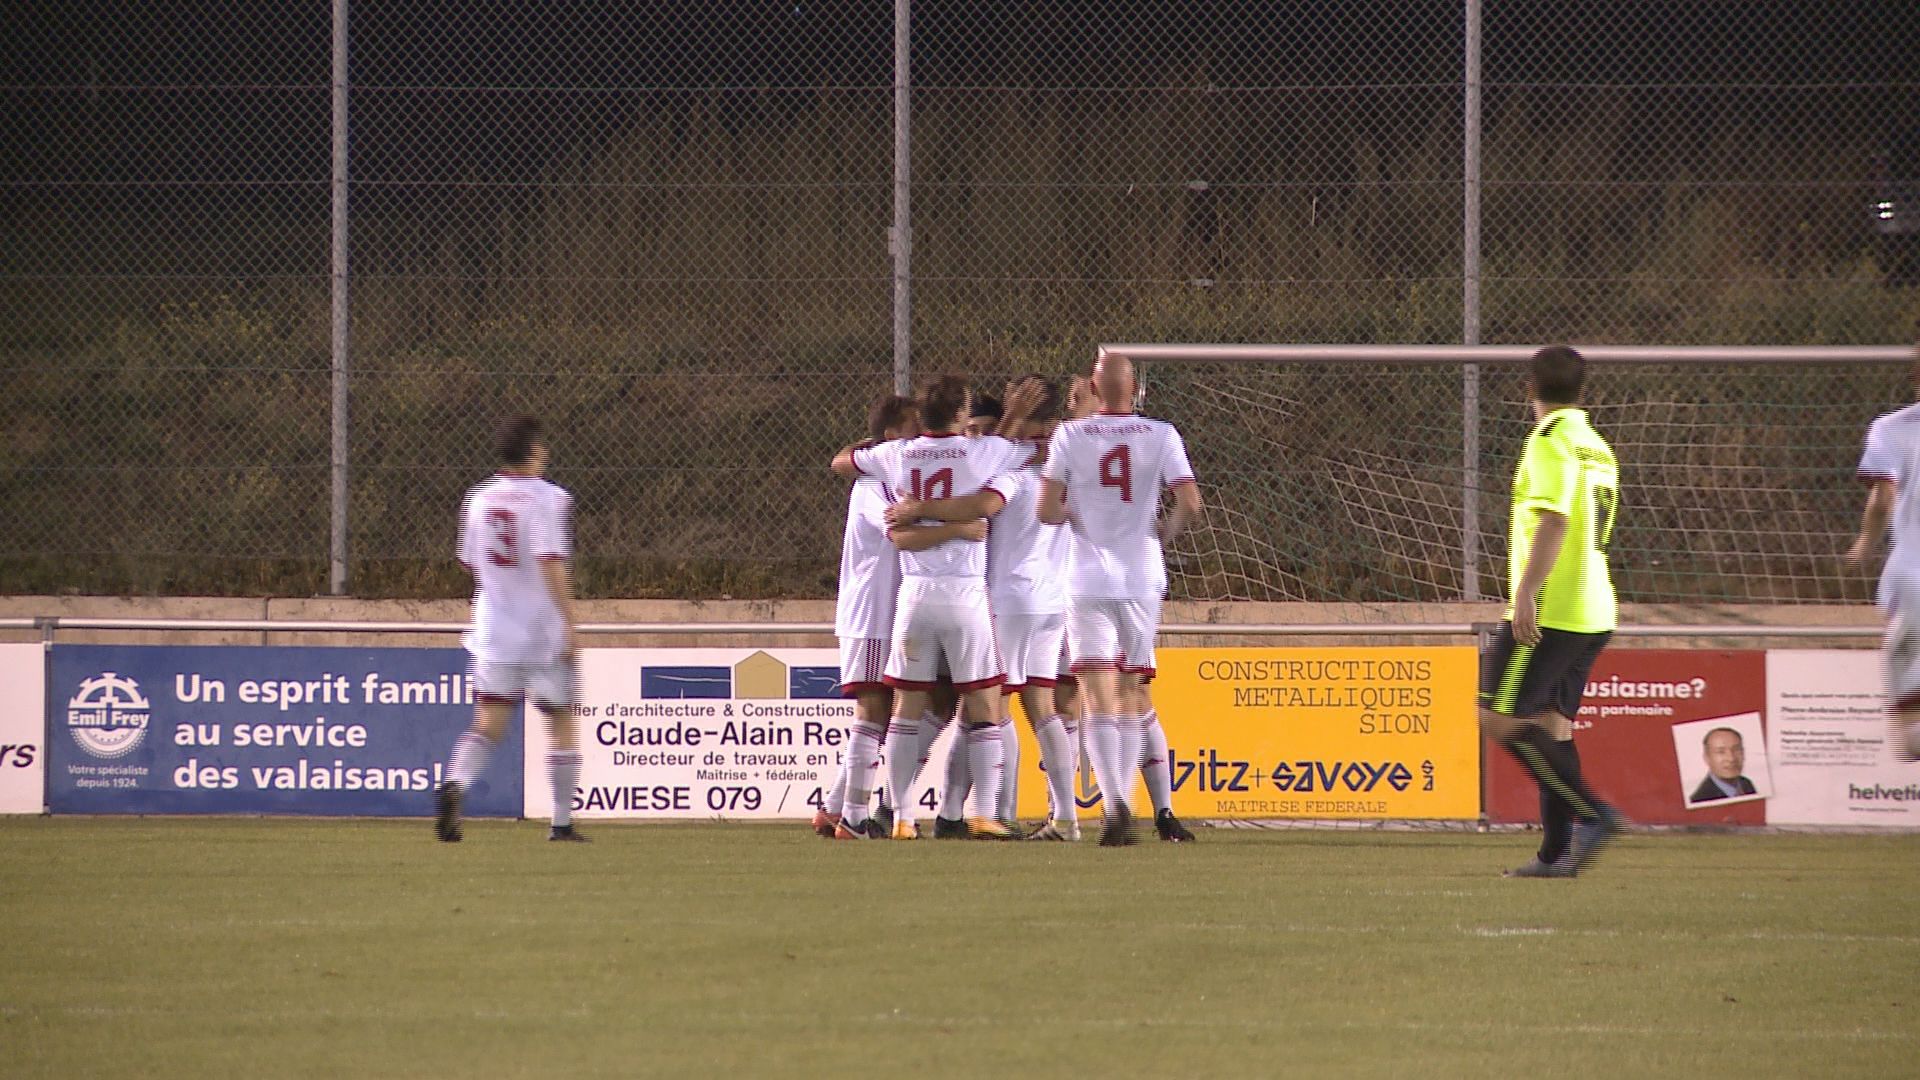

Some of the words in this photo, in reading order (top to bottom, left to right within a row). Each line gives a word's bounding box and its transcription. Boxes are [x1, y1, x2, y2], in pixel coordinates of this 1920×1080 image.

[486, 508, 519, 567] 3
[1198, 660, 1432, 681] CONSTRUCTIONS
[175, 674, 225, 702] Un
[238, 673, 350, 711] esprit
[361, 673, 474, 705] famili
[1583, 675, 1706, 698] usiasme?
[1233, 687, 1432, 710] METALLIQUES
[68, 710, 107, 726] Emil
[111, 711, 150, 729] Frey
[605, 703, 715, 717] d'architecture
[723, 704, 734, 717] &
[742, 703, 854, 717] Constructions
[1576, 705, 1598, 715] on
[1601, 703, 1673, 718] partenaire
[174, 723, 221, 746] au
[233, 717, 368, 747] service
[596, 720, 793, 746] Claude-Alain
[1359, 713, 1431, 734] SION
[613, 751, 695, 766] Directeur
[703, 751, 725, 766] de
[734, 752, 797, 766] travaux
[806, 755, 828, 766] en
[68, 765, 96, 775] Votre
[98, 765, 149, 777] spécialiste
[173, 758, 239, 789] des
[251, 758, 443, 792] valaisans!
[766, 769, 818, 781] fédérale
[76, 777, 110, 788] depuis
[571, 786, 691, 811] SAVIESE
[706, 786, 762, 811] 079
[1216, 801, 1300, 813] MAITRISE
[1305, 802, 1388, 813] FEDERALE
